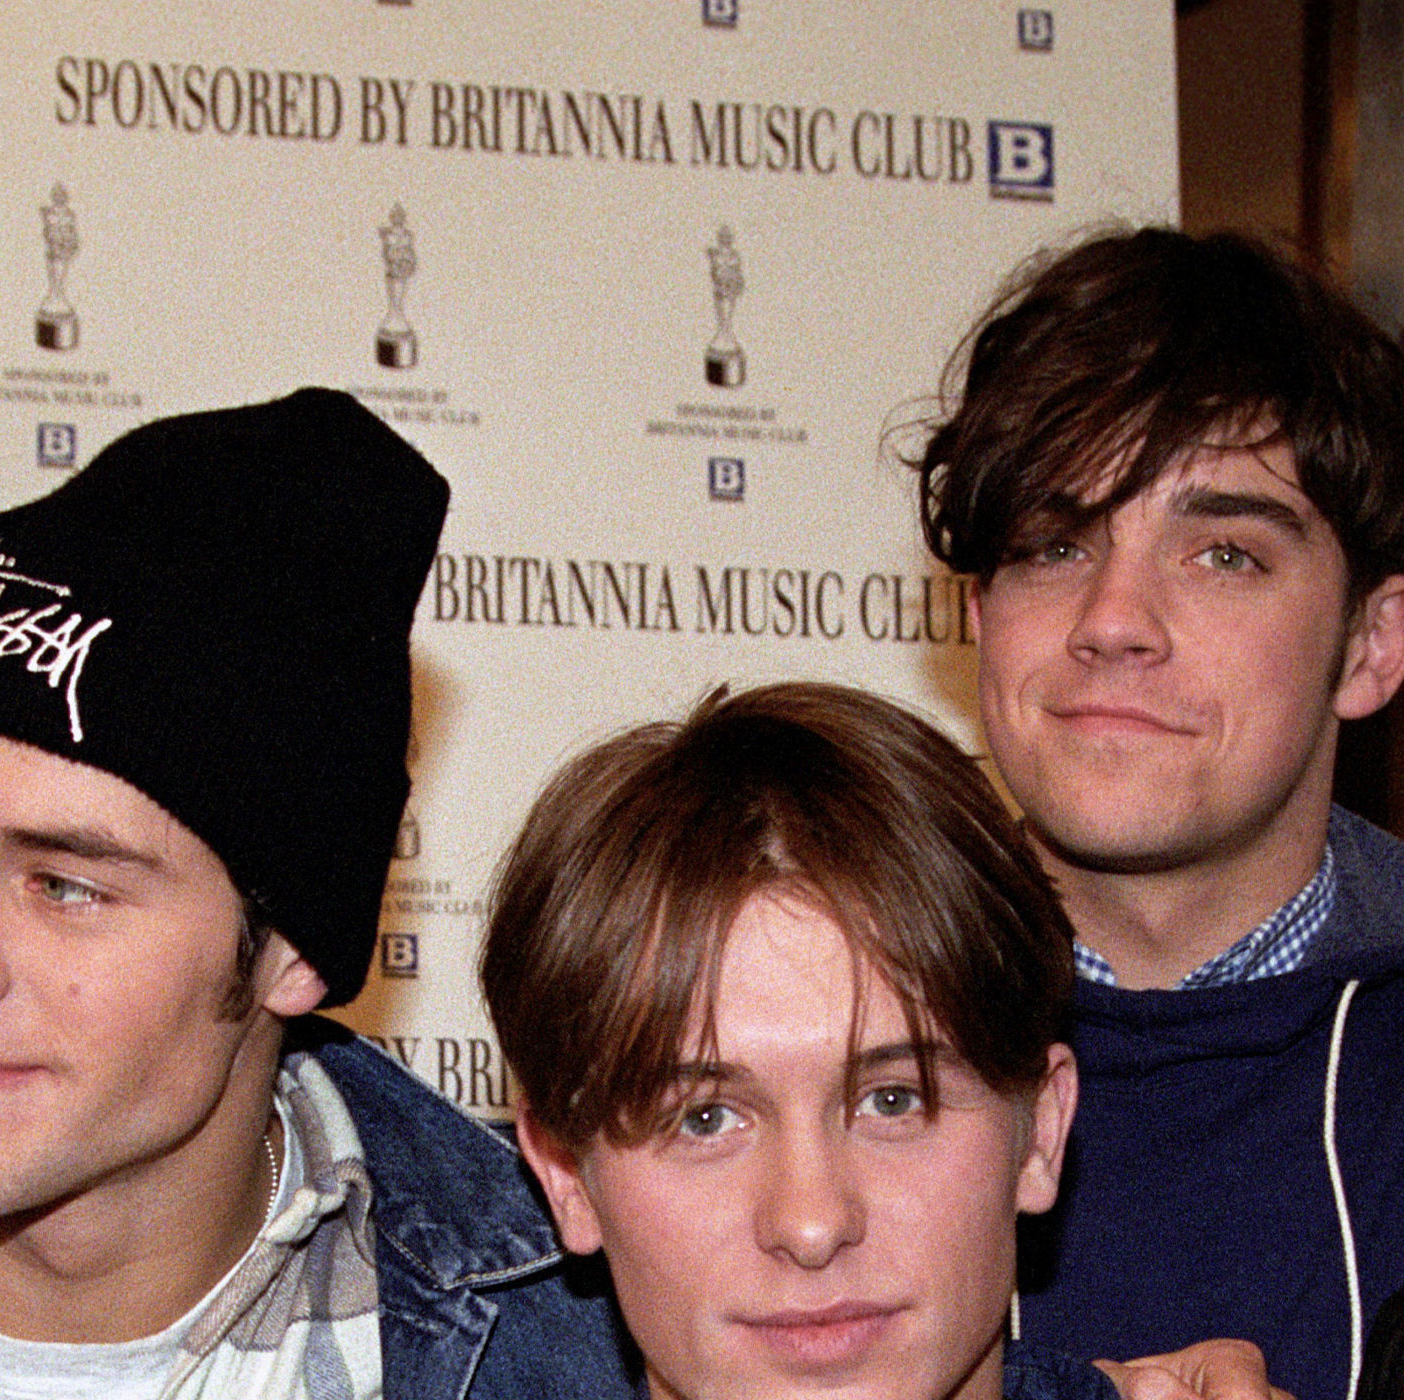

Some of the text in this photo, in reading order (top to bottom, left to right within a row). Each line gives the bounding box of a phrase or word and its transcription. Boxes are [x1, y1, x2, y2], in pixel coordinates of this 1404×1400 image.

[55, 55, 343, 142] SPONSORED
[359, 76, 416, 147] BY
[431, 81, 675, 165] BRITANNIA
[691, 100, 836, 175] MUSIC
[851, 110, 974, 184] CLUB
[434, 552, 682, 634] BRITANNIA
[694, 565, 845, 640] MUSIC
